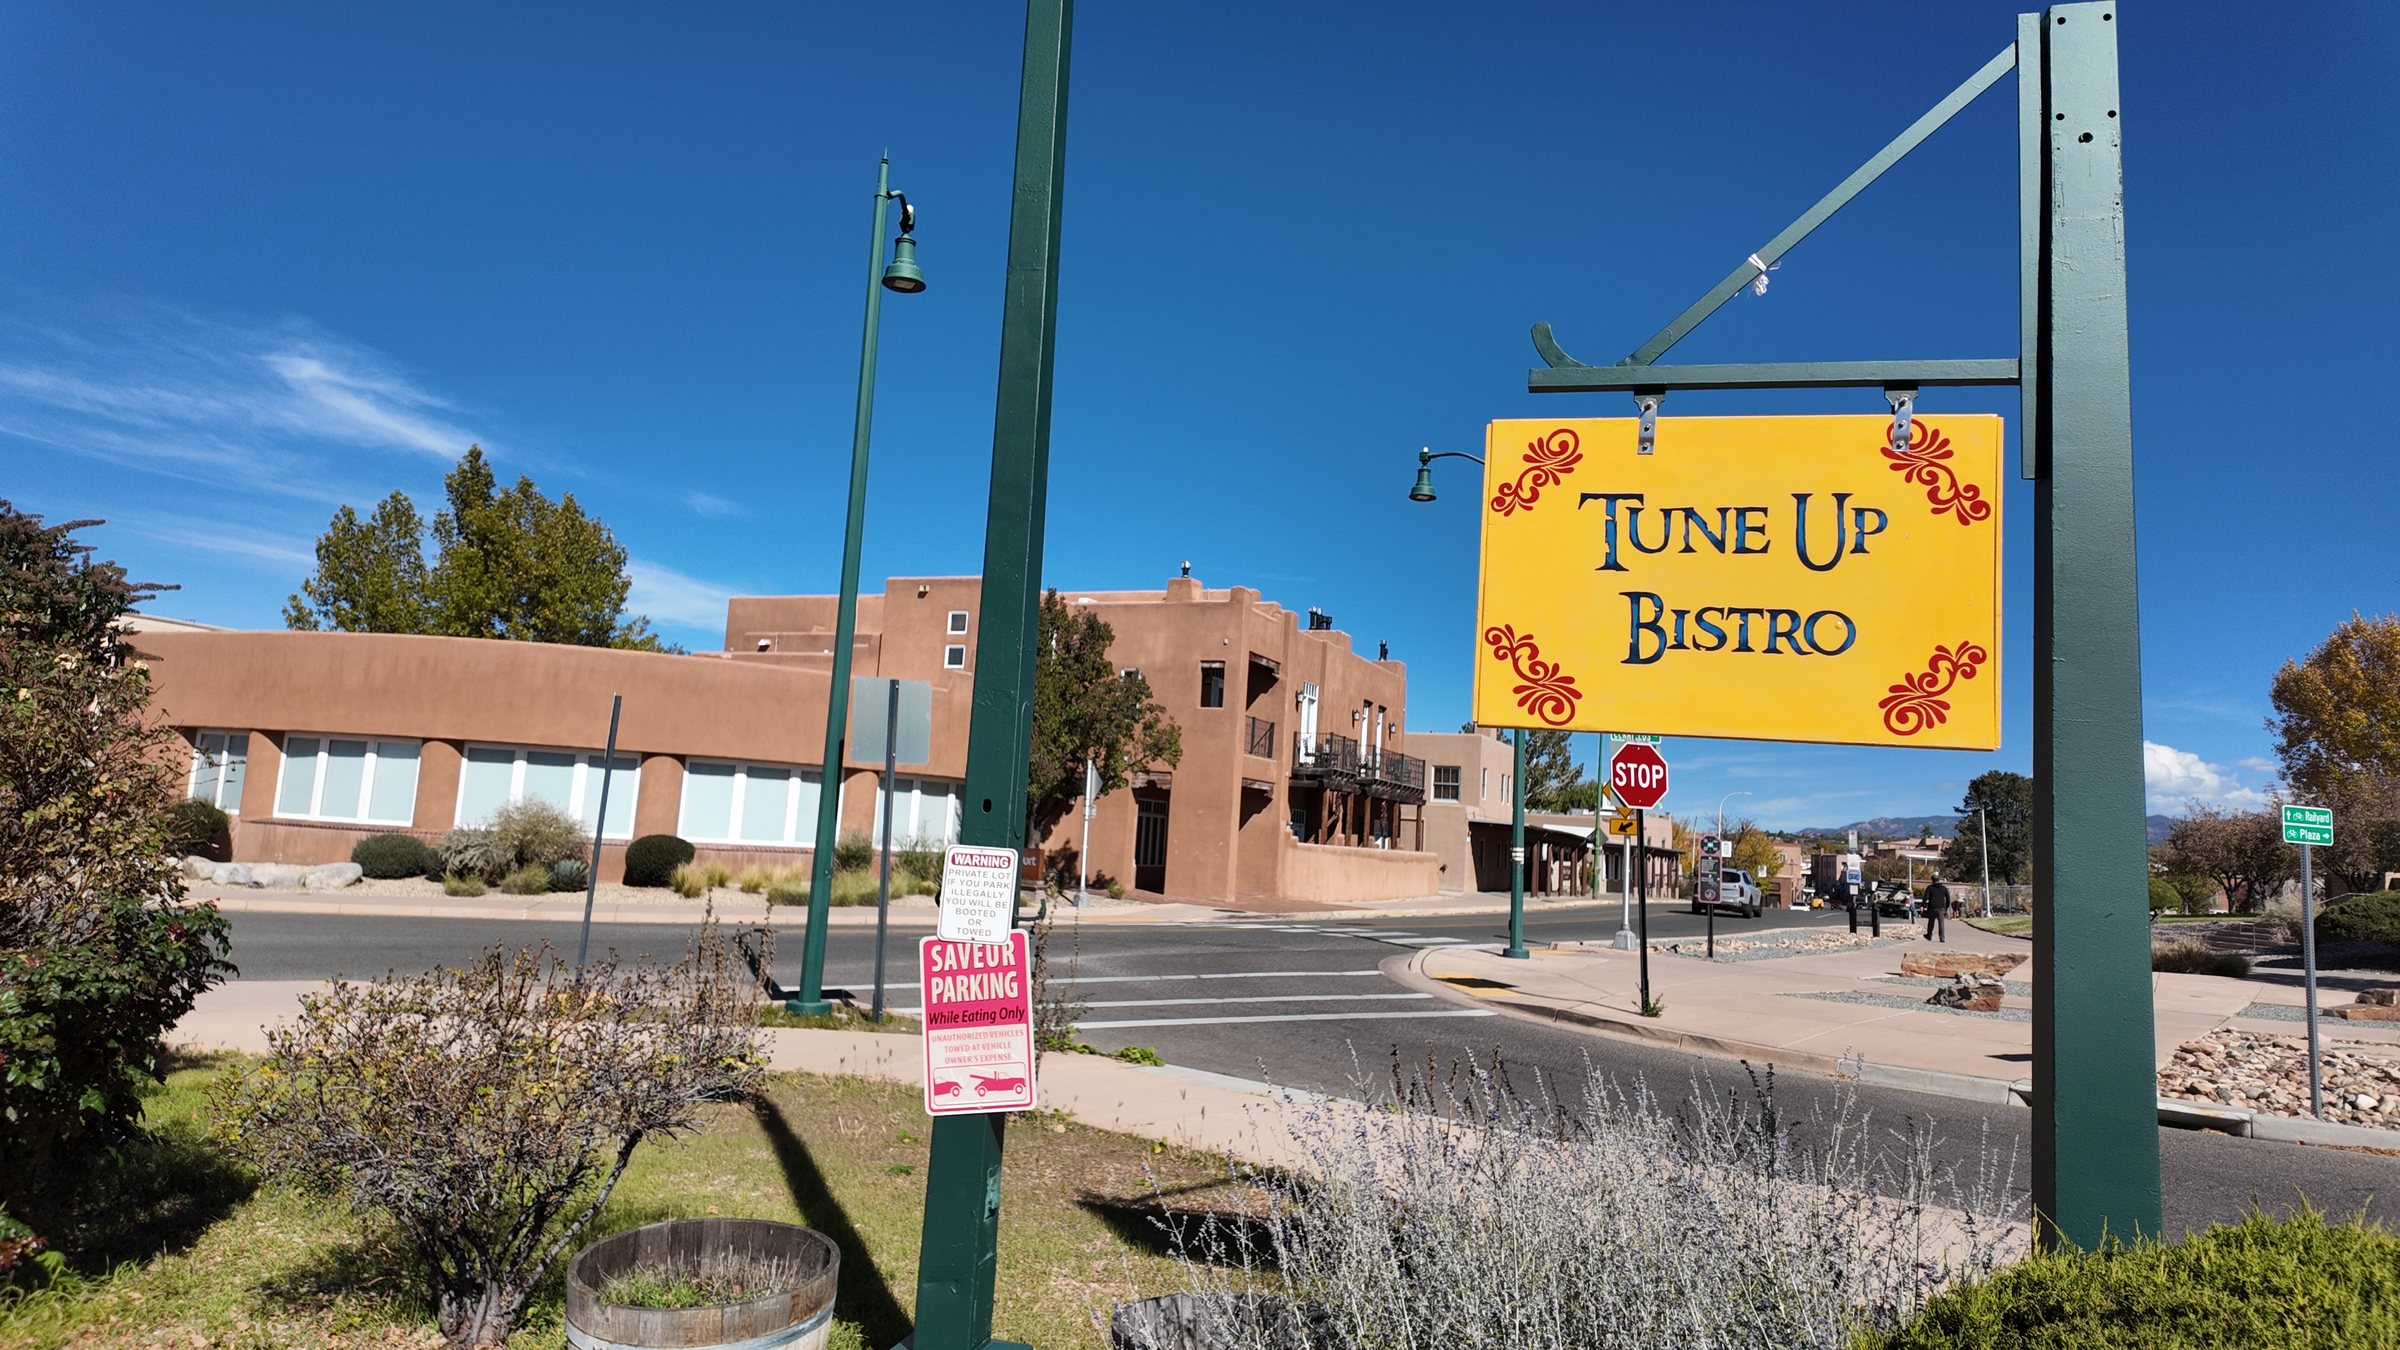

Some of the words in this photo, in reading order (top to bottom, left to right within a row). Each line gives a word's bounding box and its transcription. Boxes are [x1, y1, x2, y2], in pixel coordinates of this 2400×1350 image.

[1578, 493, 1771, 572] TUNE
[1791, 492, 1888, 572] UP
[1619, 592, 1857, 665] BISTRO
[1615, 762, 1664, 789] STOP
[2305, 811, 2330, 825] Railyard
[2300, 829, 2321, 841] Plaza
[954, 853, 1009, 868] WARNING
[1023, 856, 1036, 866] urt
[948, 869, 988, 879] PRIVATE
[992, 871, 1011, 880] LOT
[960, 879, 980, 888] YOU
[983, 881, 1010, 889] PARK
[951, 889, 1004, 898] ILLEGALLY
[946, 898, 966, 906] YOU
[969, 899, 992, 908] WILL
[995, 901, 1008, 909] BE
[955, 908, 997, 918] BOOTED
[968, 918, 982, 926] OR
[957, 927, 992, 937] TOWED
[931, 940, 1016, 972] SAVEUR
[931, 971, 1019, 1005] PARKING
[929, 1010, 959, 1024] While
[961, 1008, 997, 1023] Eating
[999, 1006, 1025, 1022] Only
[931, 1031, 988, 1042] UNAUTHORIZED
[989, 1029, 1024, 1038] VEHICLES
[944, 1044, 970, 1053] TOWED
[972, 1043, 980, 1051] AT
[981, 1042, 1012, 1050] VEHICLE
[945, 1055, 979, 1064] OWNER'S
[980, 1053, 1012, 1062] EXPENSE
